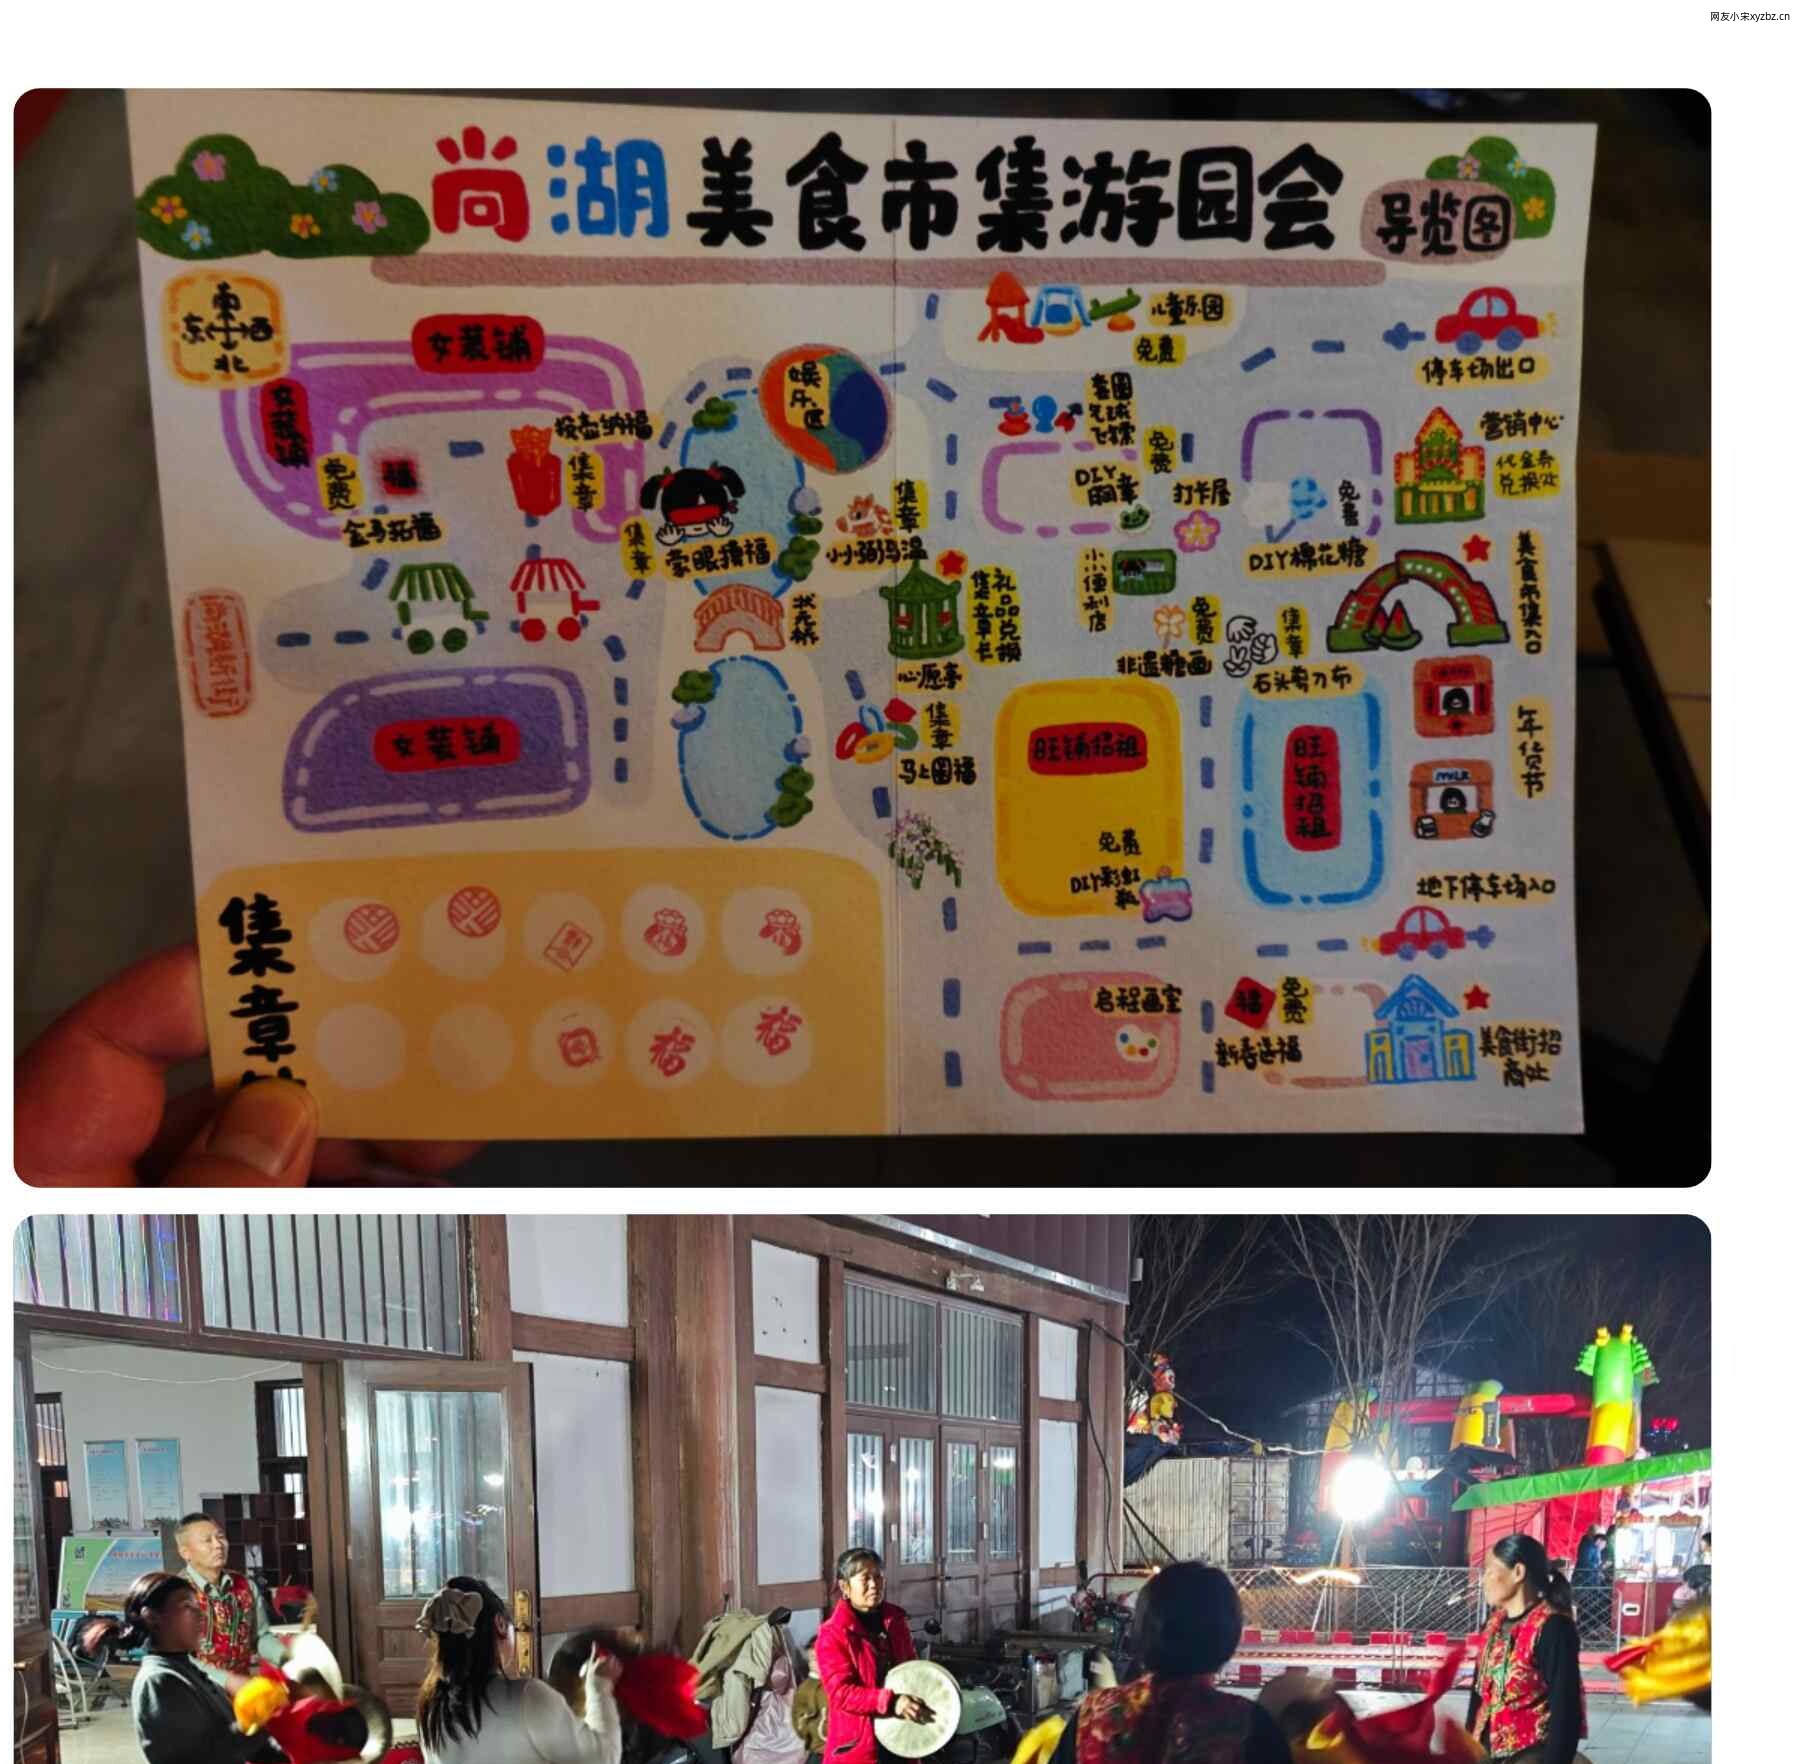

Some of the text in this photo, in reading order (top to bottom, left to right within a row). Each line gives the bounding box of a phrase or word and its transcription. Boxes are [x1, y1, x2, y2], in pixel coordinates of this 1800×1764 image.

[432, 124, 1345, 256] 尚湖美食市集游园会
[1374, 187, 1513, 257] 导览图
[1151, 291, 1224, 326] 儿童乐园
[213, 353, 250, 374] 北
[1421, 356, 1536, 387] 停车场出口
[1479, 410, 1565, 442] 营销中心
[1075, 465, 1117, 487] DIY
[1172, 477, 1232, 507] 打卡屋
[1249, 535, 1369, 573] DIY棉花糖
[1081, 546, 1110, 634] 小小便利店
[1514, 529, 1544, 656] 美食市集入口
[1252, 663, 1353, 695] 石头剪刀布
[1516, 704, 1546, 799] 年货节
[1415, 871, 1557, 902] 地下停车场入口
[218, 893, 306, 1088] 集章
